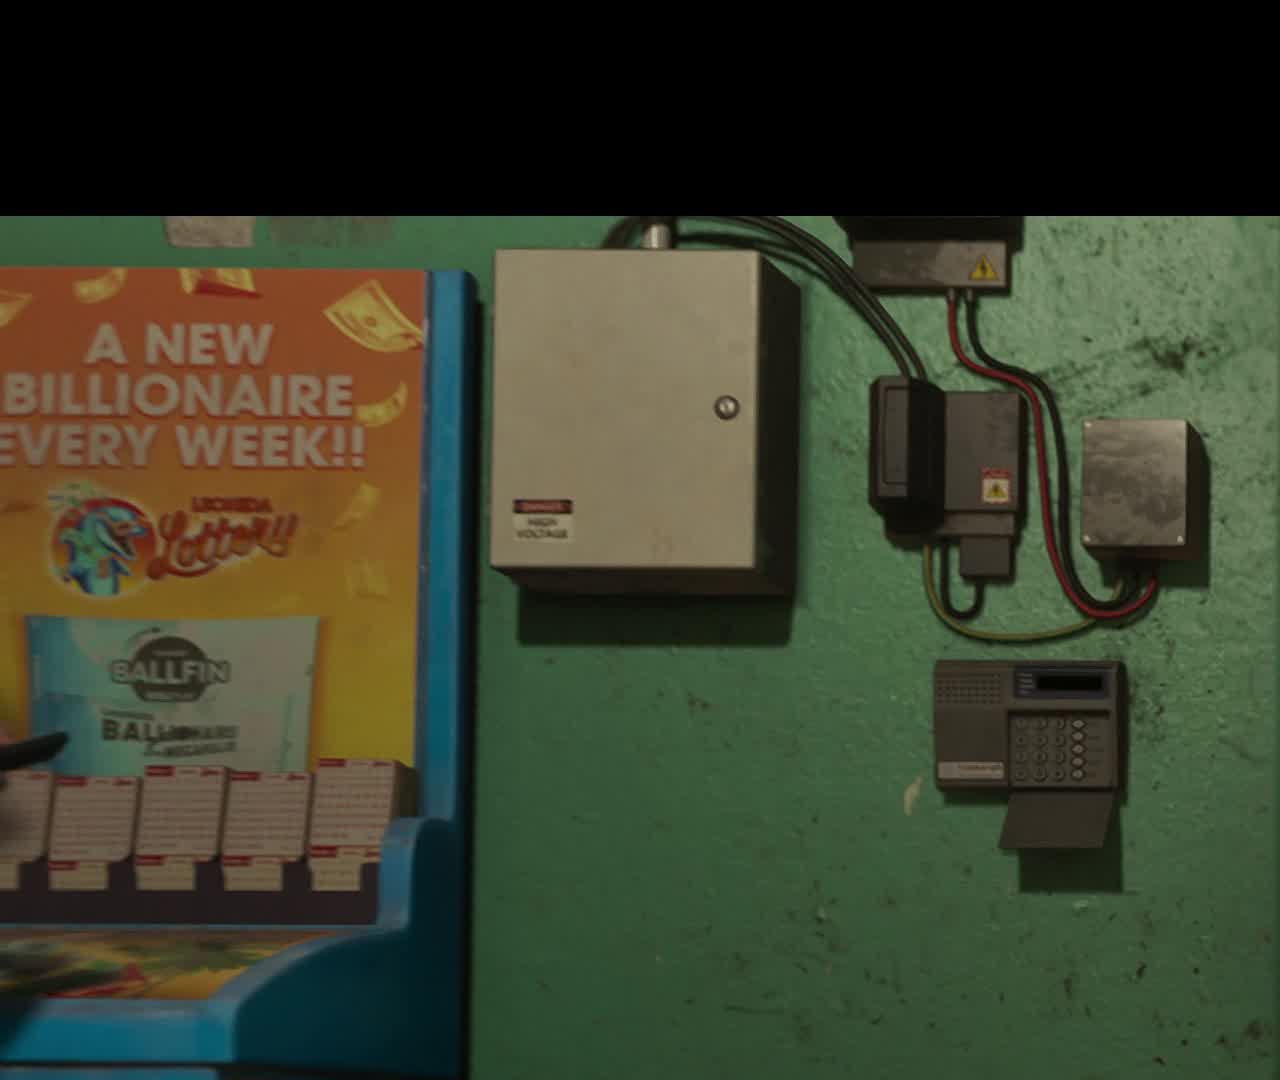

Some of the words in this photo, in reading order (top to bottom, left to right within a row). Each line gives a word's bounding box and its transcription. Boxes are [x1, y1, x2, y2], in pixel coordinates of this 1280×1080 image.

[84, 323, 128, 364] A
[145, 323, 273, 364] NEW
[4, 373, 354, 417] BILLIONAIRE
[176, 424, 367, 468] WEEK!!
[110, 659, 231, 685] BALLFIN
